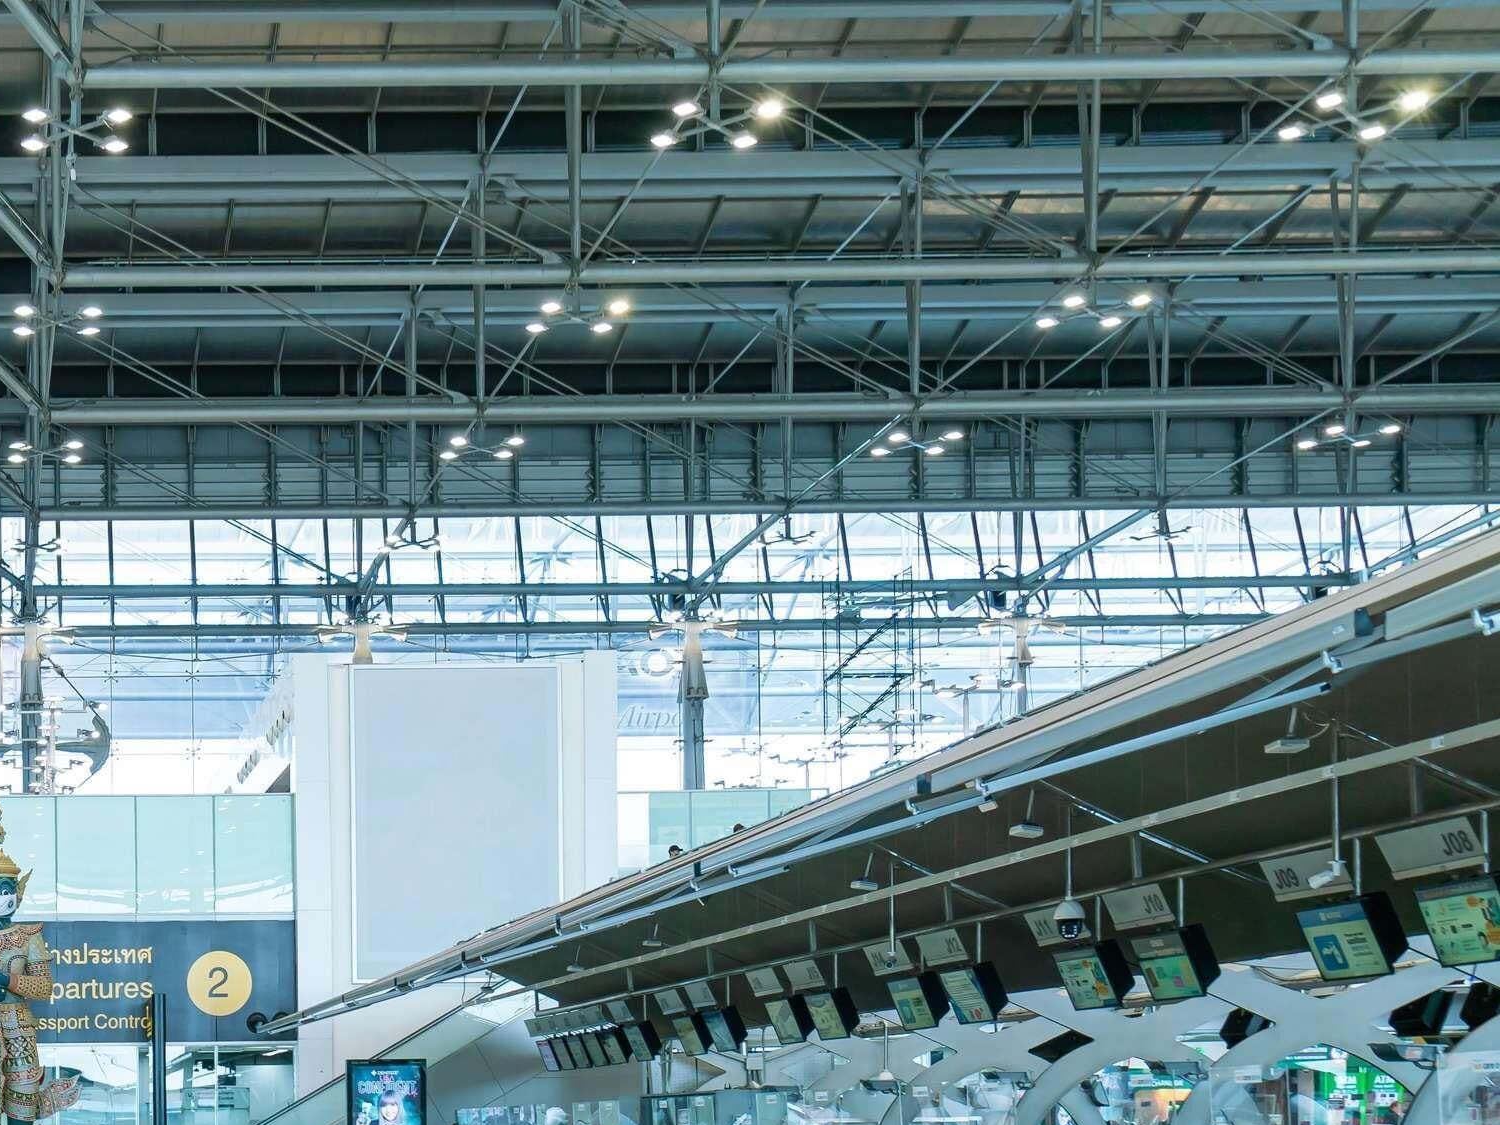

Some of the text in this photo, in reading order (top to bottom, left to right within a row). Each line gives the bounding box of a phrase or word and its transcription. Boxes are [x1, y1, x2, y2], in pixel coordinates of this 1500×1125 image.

[1440, 829, 1474, 857] J08
[1272, 867, 1300, 890] J09
[1143, 893, 1165, 914] J10
[50, 979, 154, 1005] partures
[208, 966, 229, 998] 2
[36, 1015, 90, 1033] ssport
[94, 1013, 153, 1030] Contro
